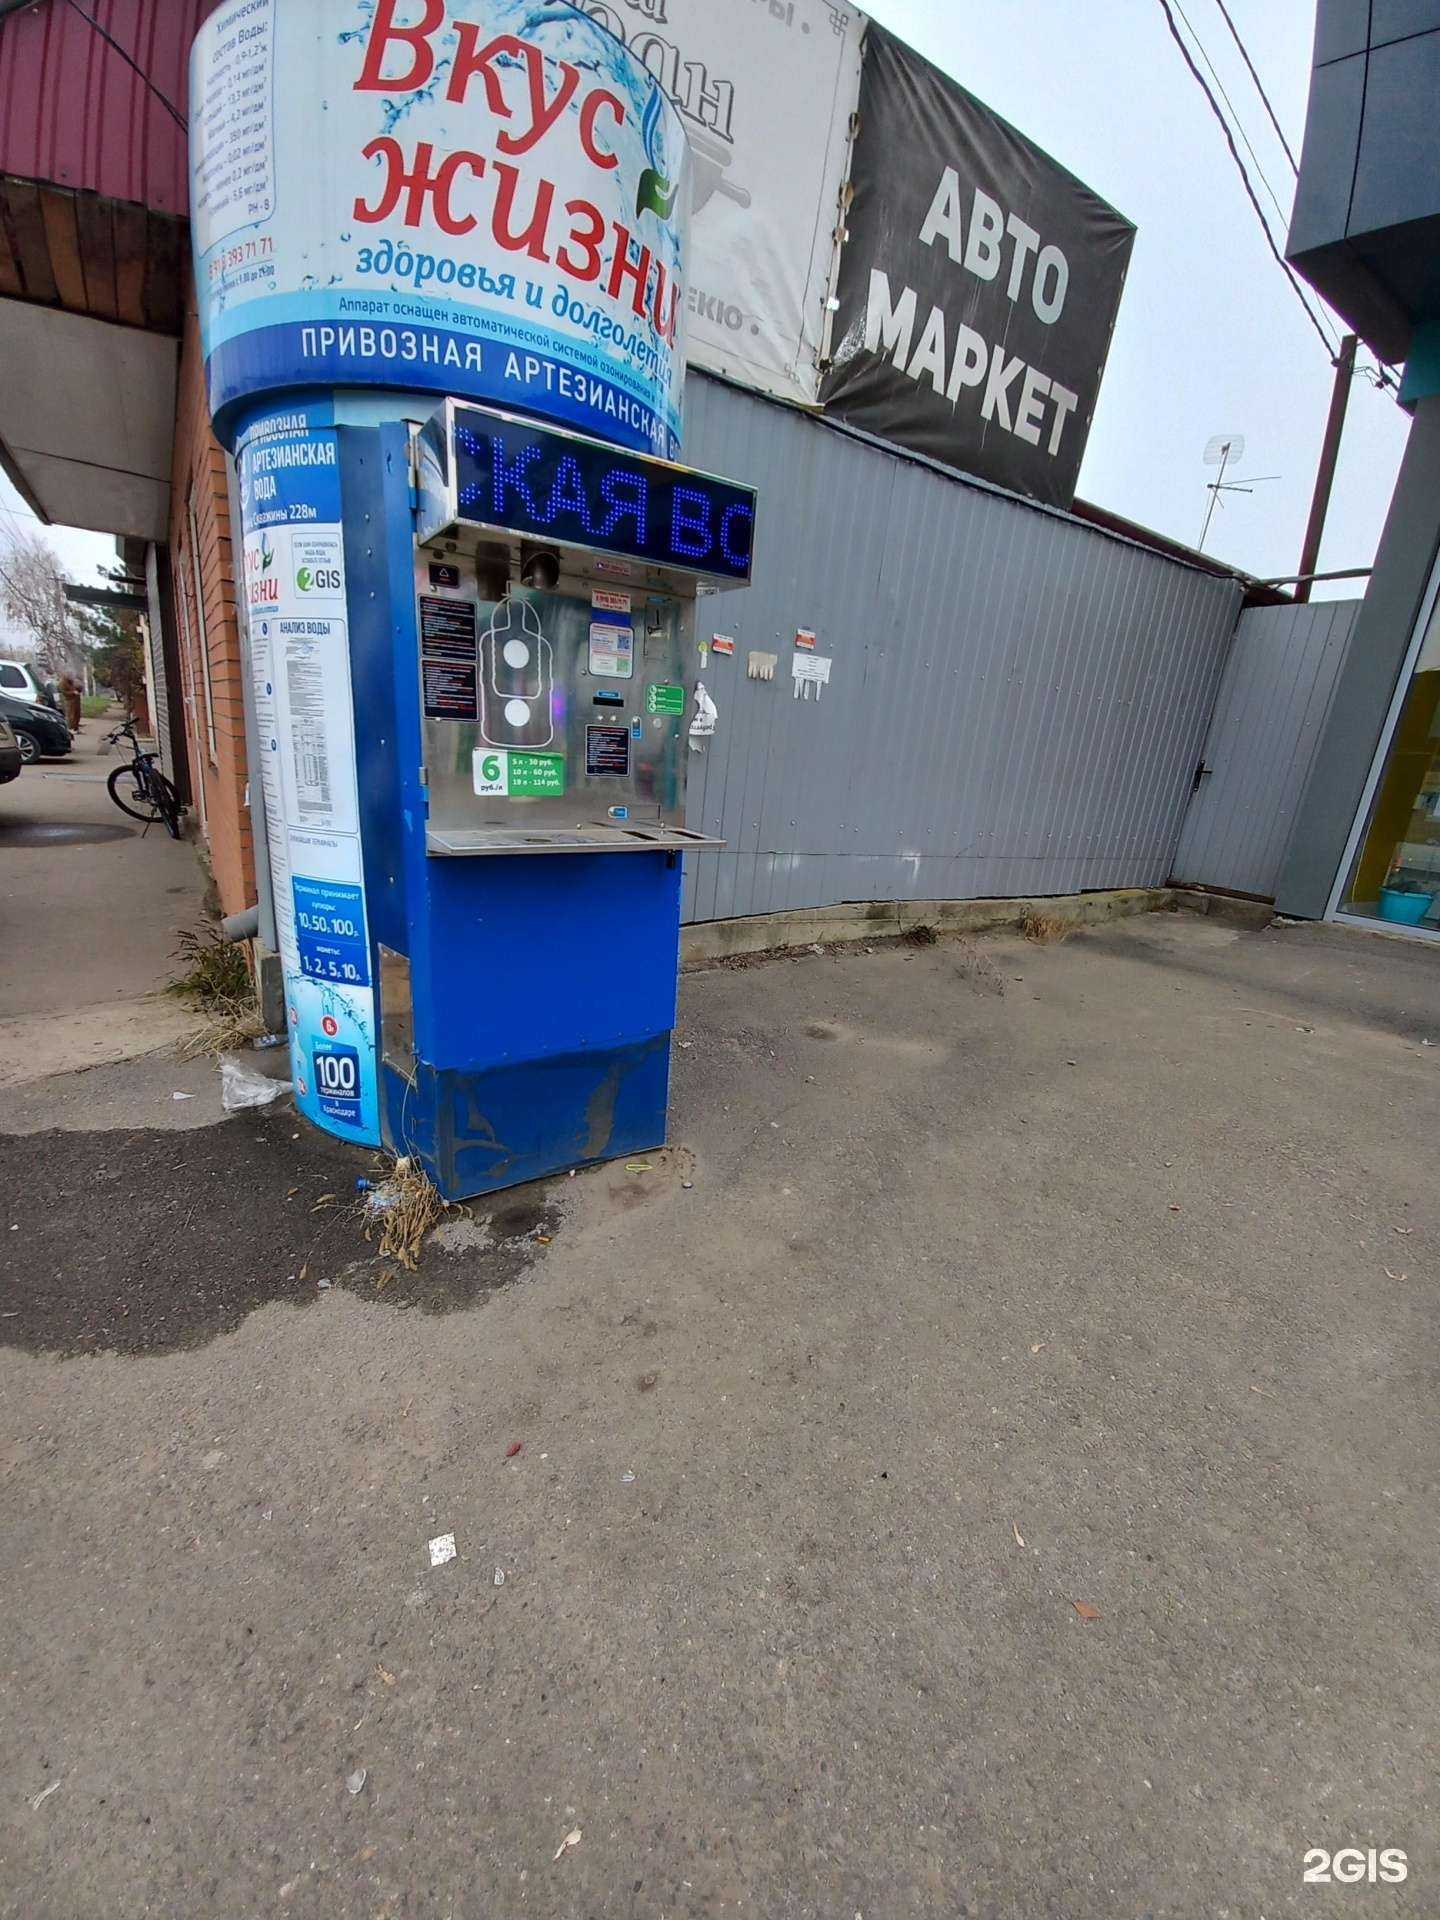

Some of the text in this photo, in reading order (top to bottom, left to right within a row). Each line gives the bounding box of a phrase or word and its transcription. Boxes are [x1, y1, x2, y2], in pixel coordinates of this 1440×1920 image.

[353, 0, 625, 170] Вкус
[245, 242, 256, 259] 71
[260, 236, 273, 255] 71
[353, 136, 678, 351] жизни
[918, 165, 1070, 325] АВТО
[356, 239, 516, 300] здоровья
[525, 281, 544, 309] и
[339, 296, 390, 315] Аппарат
[393, 302, 449, 322] оснащен
[452, 312, 551, 348] автоматической
[552, 340, 600, 368] системой
[864, 267, 1079, 457] МАРКЕТ
[302, 327, 482, 372] ПРИВОЗНАЯ
[504, 356, 666, 449] АРТЕЗИАНСКАЯ
[253, 442, 336, 474] АРТЕЗИАНСКАЯ
[254, 475, 277, 500] ВОДА
[289, 504, 318, 520] 228м
[297, 567, 341, 591] 2GIS
[280, 621, 331, 635] АНАЛИЗ ВОДЫ
[482, 755, 500, 782] 6
[316, 1055, 355, 1089] 100
